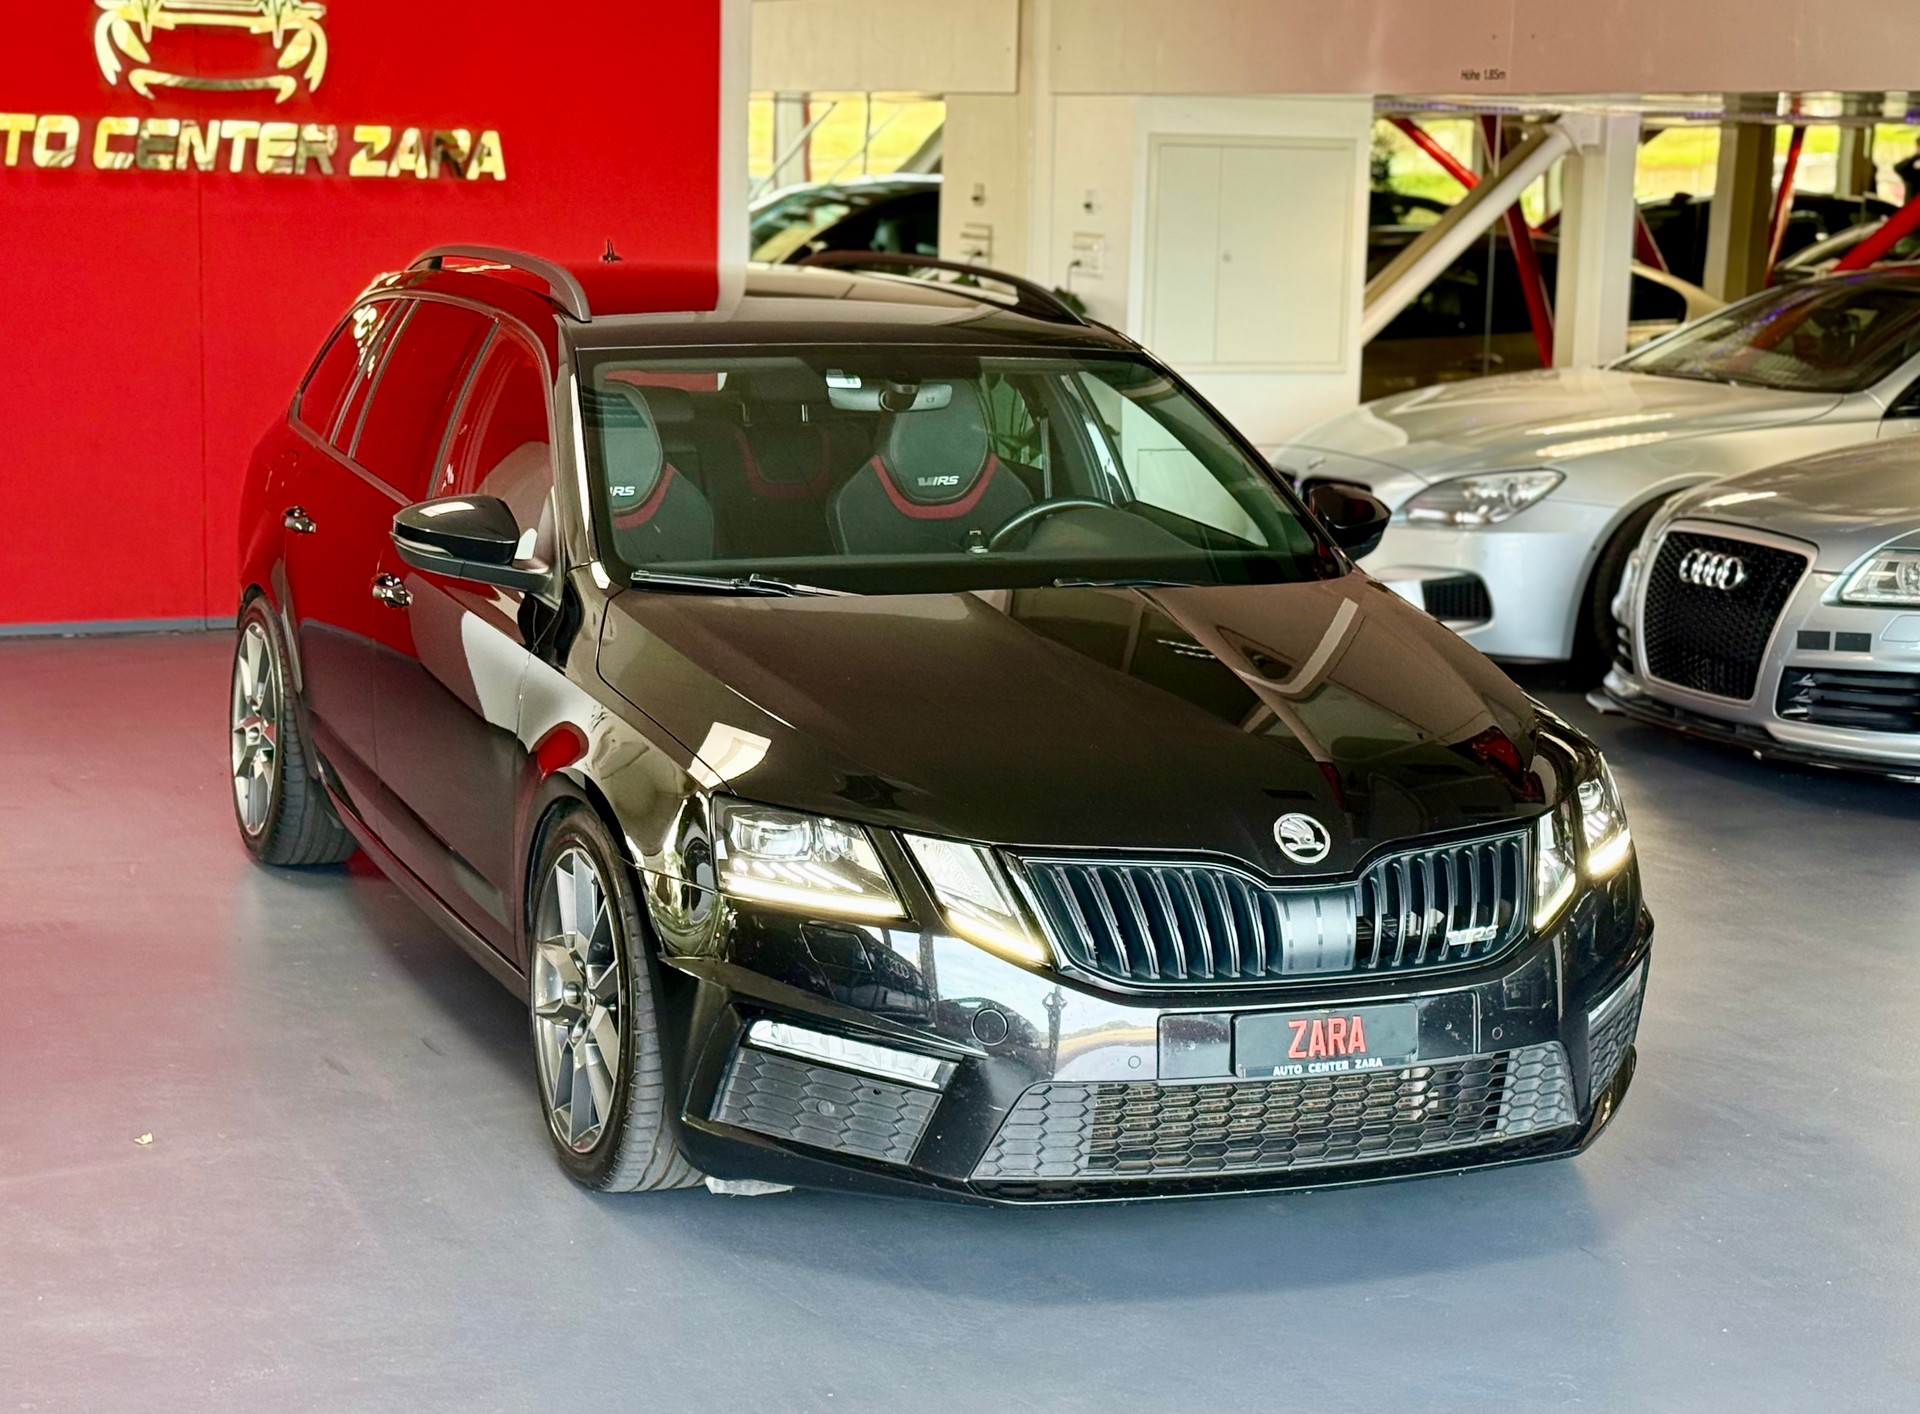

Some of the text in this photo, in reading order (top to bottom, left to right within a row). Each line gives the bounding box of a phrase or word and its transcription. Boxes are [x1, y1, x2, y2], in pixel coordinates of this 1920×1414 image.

[93, 116, 338, 175] CENTER
[349, 124, 506, 181] ZARA
[1288, 1014, 1366, 1059] ZARA
[1272, 1057, 1383, 1077] AUTO CENTER ZARA
